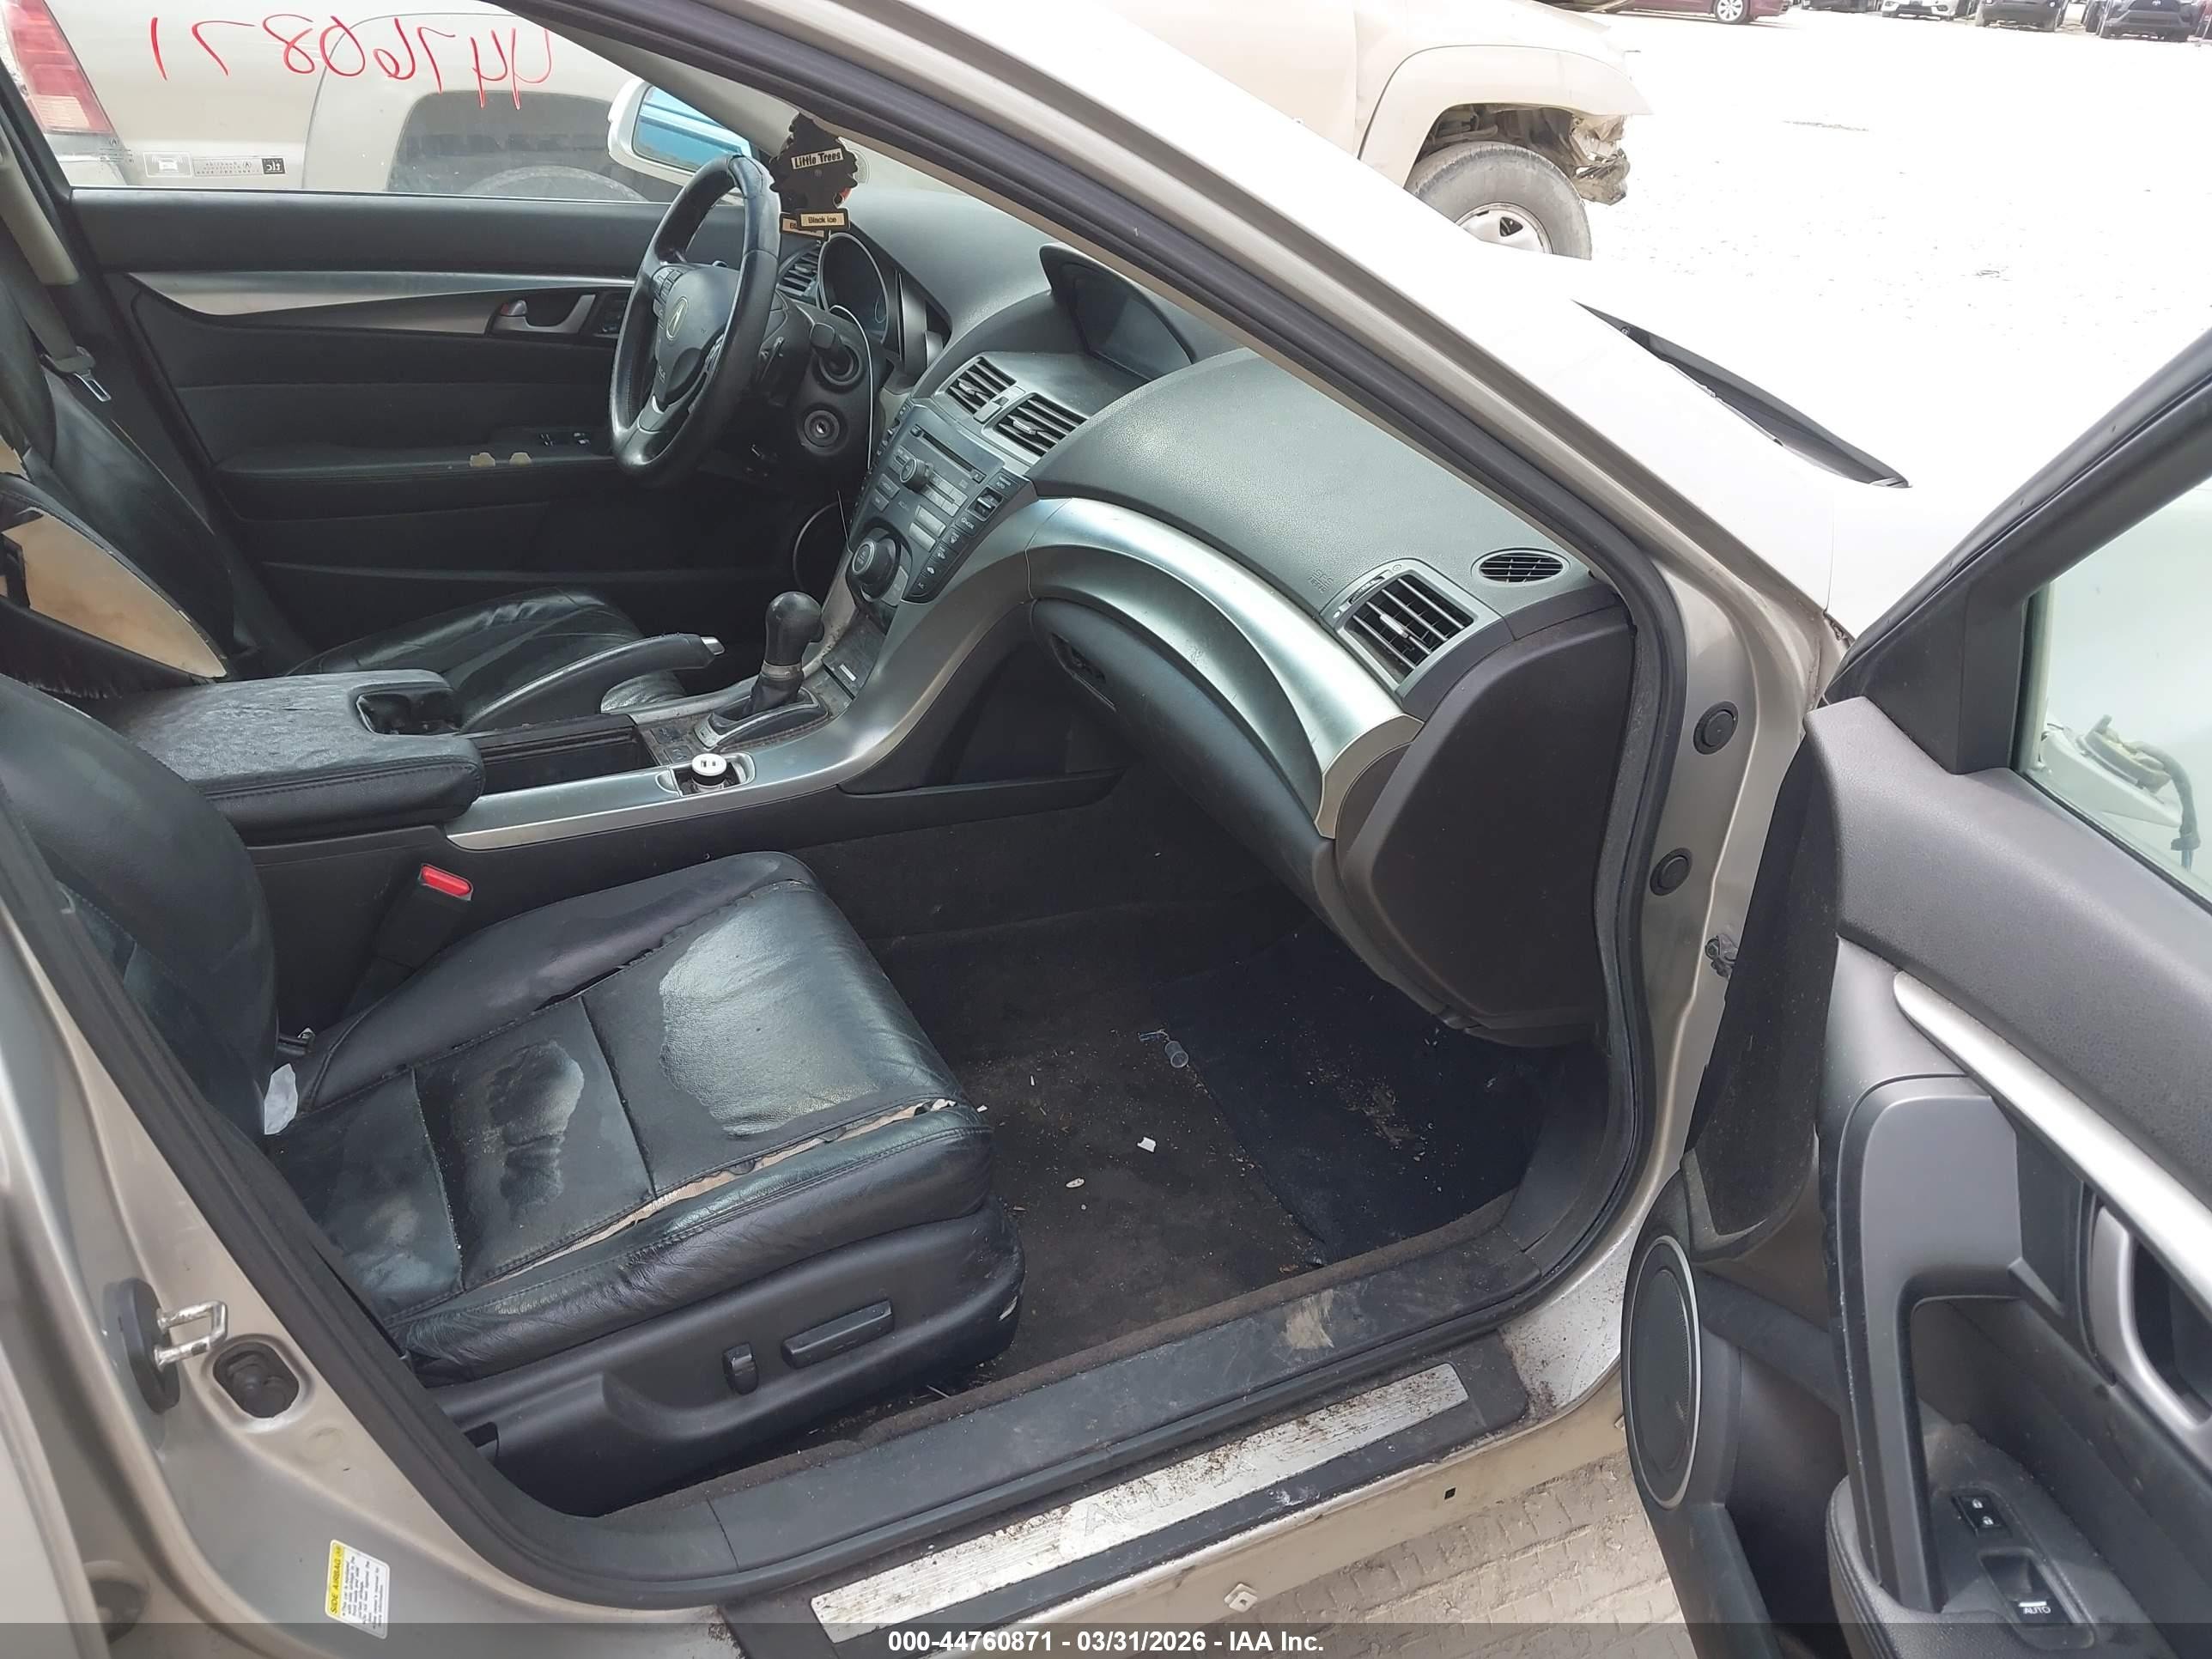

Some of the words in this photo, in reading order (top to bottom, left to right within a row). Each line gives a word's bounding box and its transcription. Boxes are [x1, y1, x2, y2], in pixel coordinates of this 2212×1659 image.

[794, 156, 817, 168] Little
[817, 151, 841, 163] Trees
[808, 216, 826, 224] Black
[332, 1559, 341, 1590] AIRBAG
[2023, 1606, 2051, 1614] AUTO
